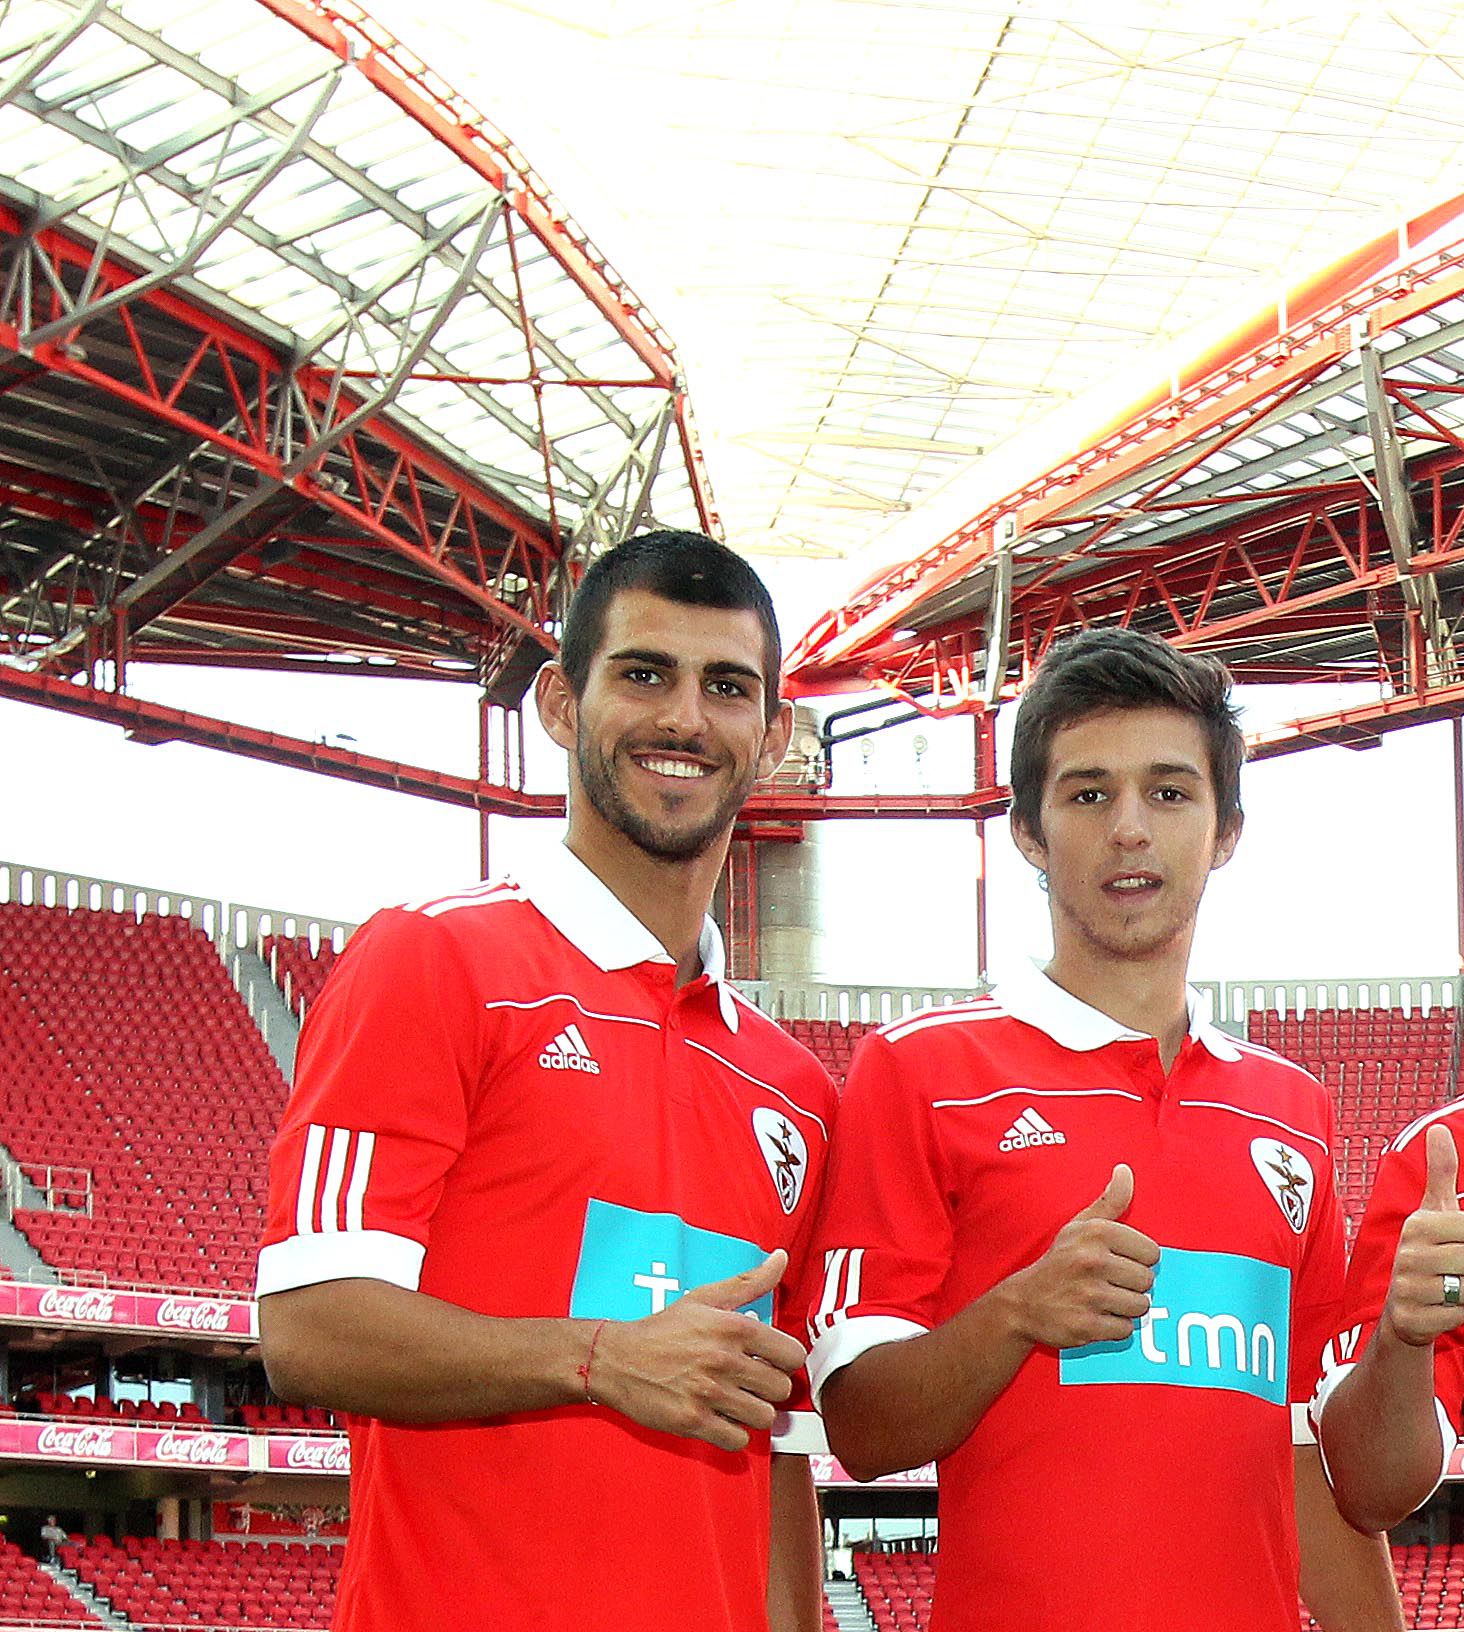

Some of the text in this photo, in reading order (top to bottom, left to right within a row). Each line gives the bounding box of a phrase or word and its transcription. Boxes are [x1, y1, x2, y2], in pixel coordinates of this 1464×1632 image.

[539, 1050, 600, 1075] adidas
[999, 1130, 1067, 1152] adidas
[39, 1289, 116, 1321] Coca-Cola
[157, 1300, 232, 1331] Coca-Cola
[1138, 1293, 1275, 1382] tmn
[38, 1424, 114, 1456] Coca-Cola
[155, 1431, 233, 1462] Coca-Cola
